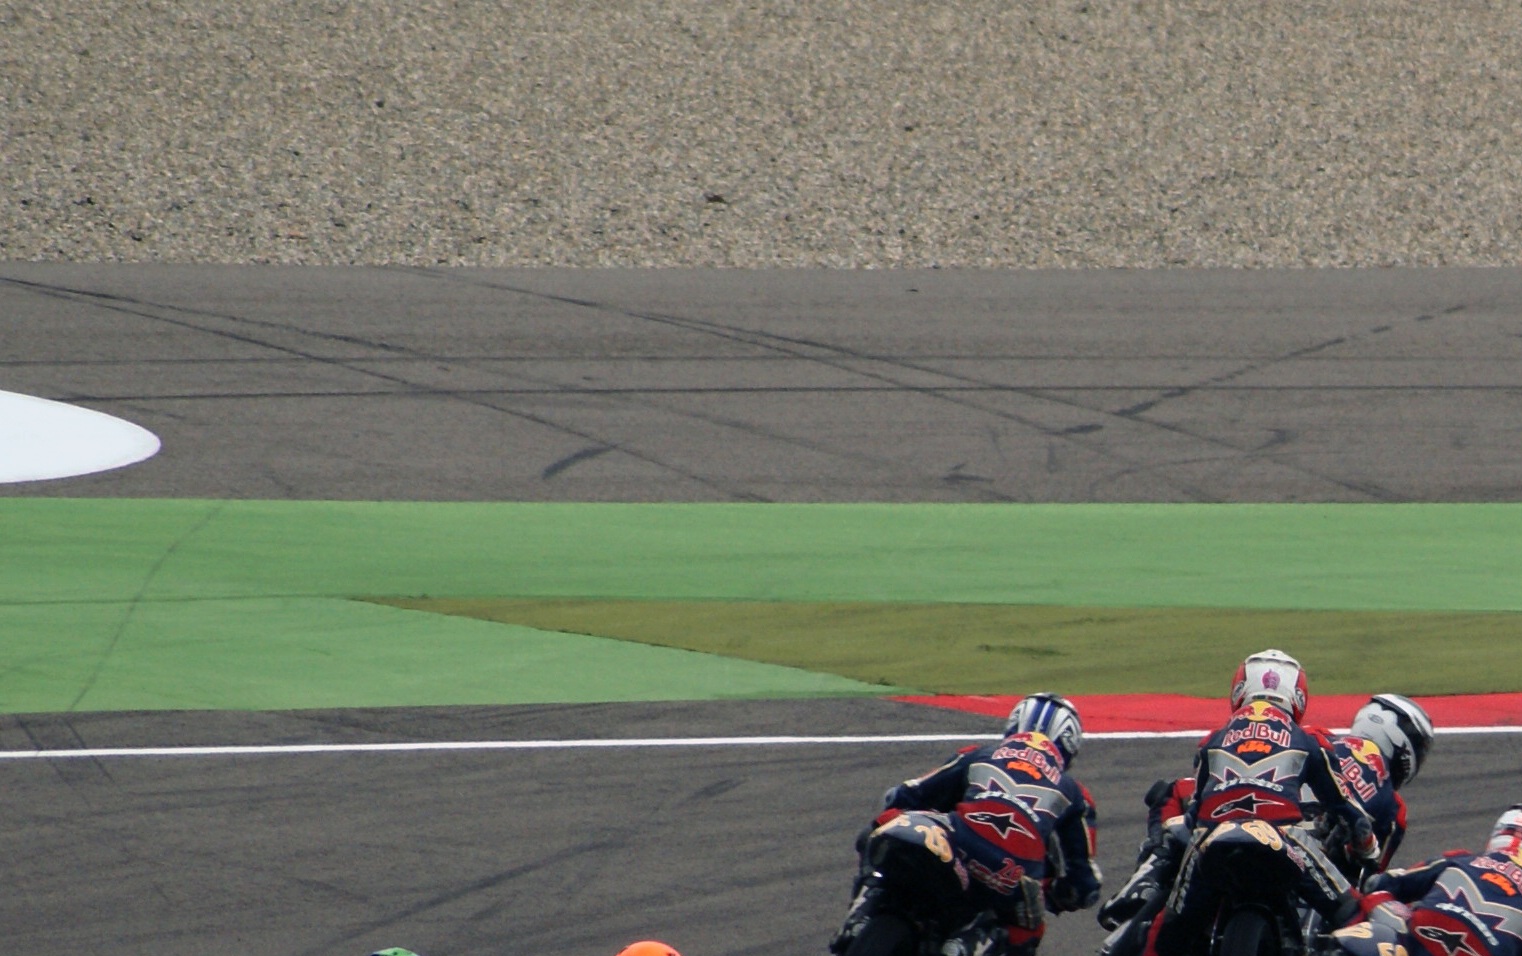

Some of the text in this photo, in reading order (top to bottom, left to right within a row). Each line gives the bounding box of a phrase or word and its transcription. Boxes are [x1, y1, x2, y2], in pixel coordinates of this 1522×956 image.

[1222, 722, 1291, 748] Red Bull
[1342, 761, 1378, 803] Bull
